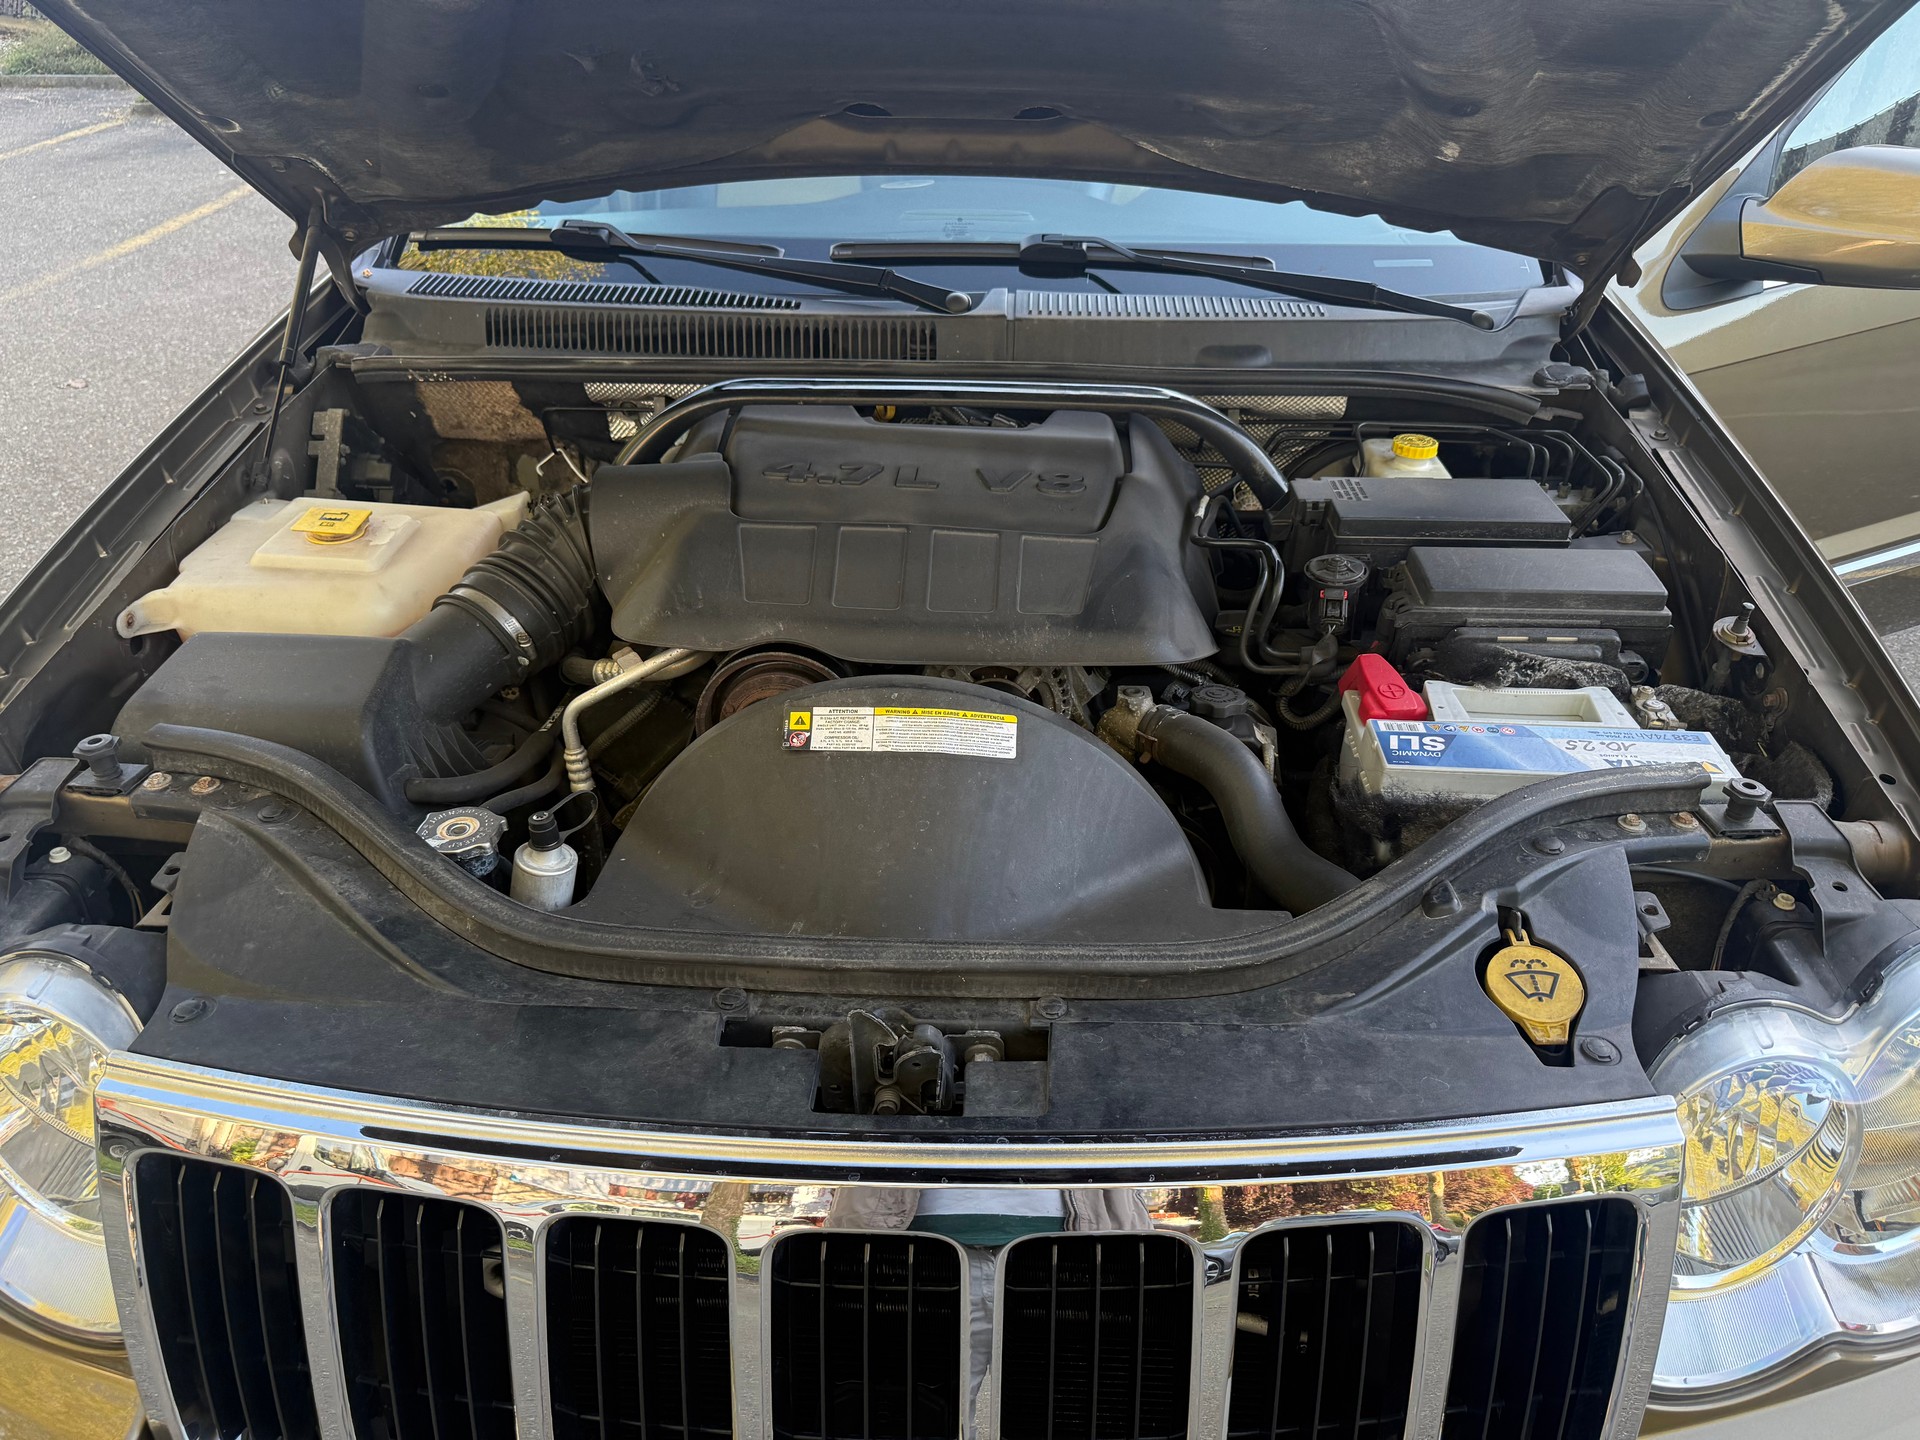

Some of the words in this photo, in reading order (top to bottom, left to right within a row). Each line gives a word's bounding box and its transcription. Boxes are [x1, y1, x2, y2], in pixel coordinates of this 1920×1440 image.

[762, 461, 940, 490] 4.7L
[976, 468, 1087, 494] V8
[1389, 735, 1446, 752] SLI
[1635, 732, 1672, 742] 74Ah
[1391, 750, 1442, 758] DYNAMIC
